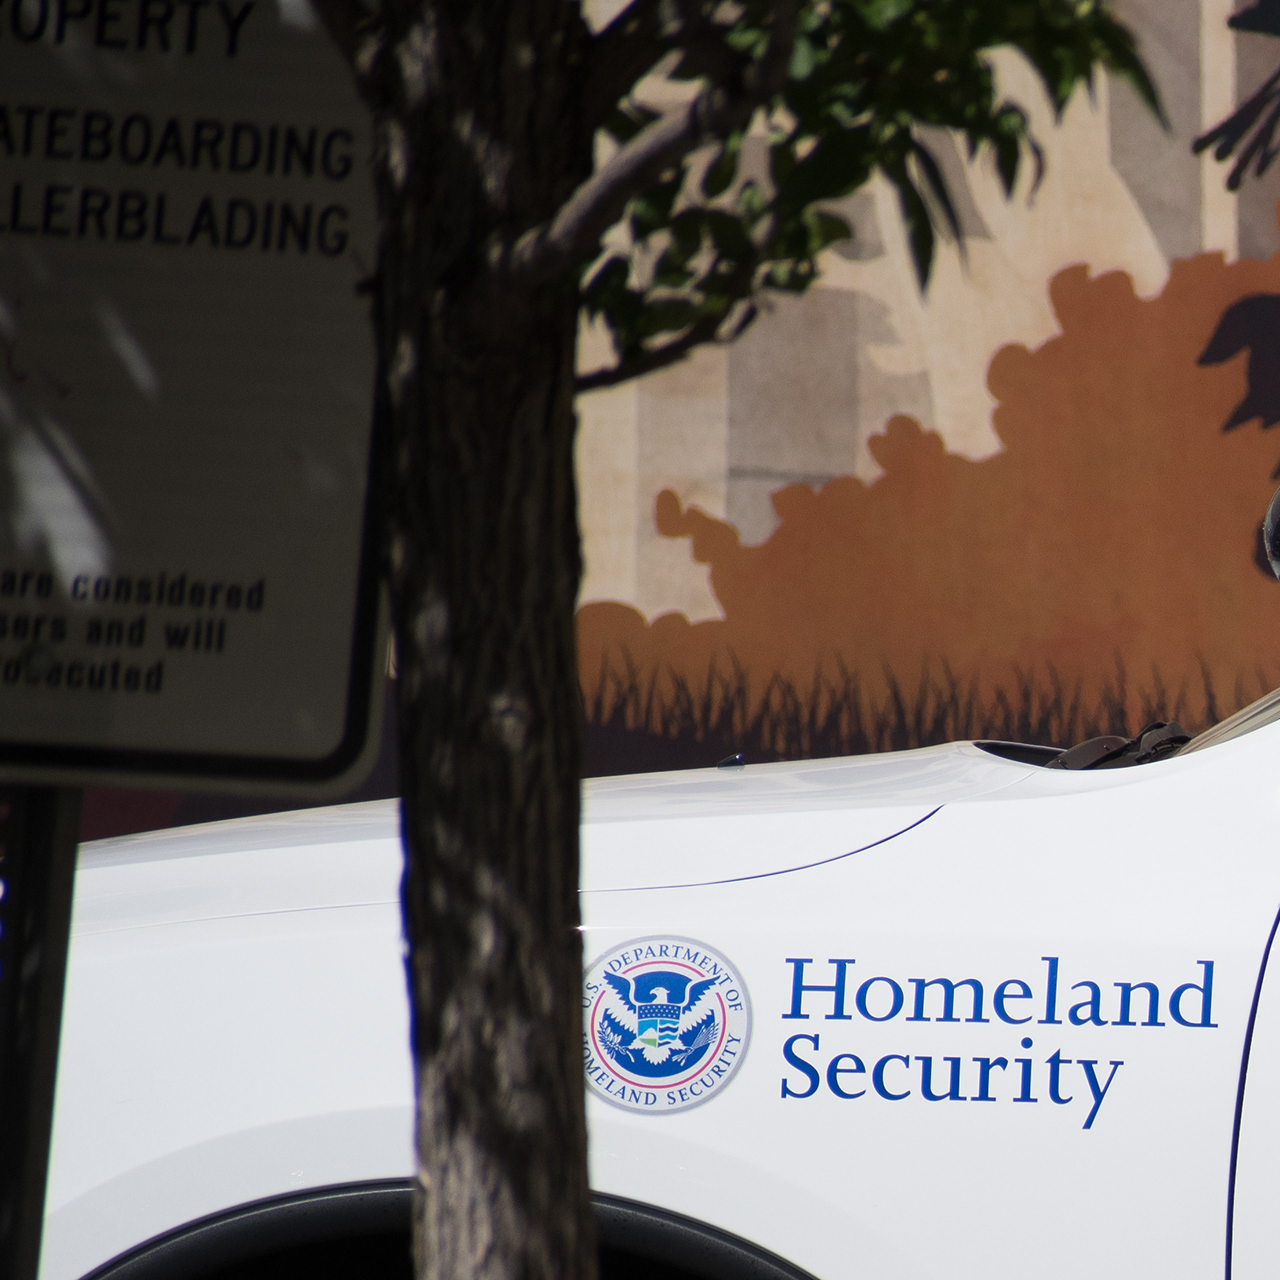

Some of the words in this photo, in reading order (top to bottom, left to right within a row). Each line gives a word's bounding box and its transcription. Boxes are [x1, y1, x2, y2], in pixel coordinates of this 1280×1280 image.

[0, 0, 255, 57] OPERTY
[1, 570, 53, 599] are
[72, 572, 266, 613] considered
[86, 614, 147, 648] and
[163, 617, 226, 653] will
[607, 944, 733, 987] DEPARTMENT
[725, 988, 743, 1012] OF
[781, 956, 1219, 1029] Homeland
[667, 1033, 741, 1105] SECURITY
[780, 1033, 1124, 1130] Security
